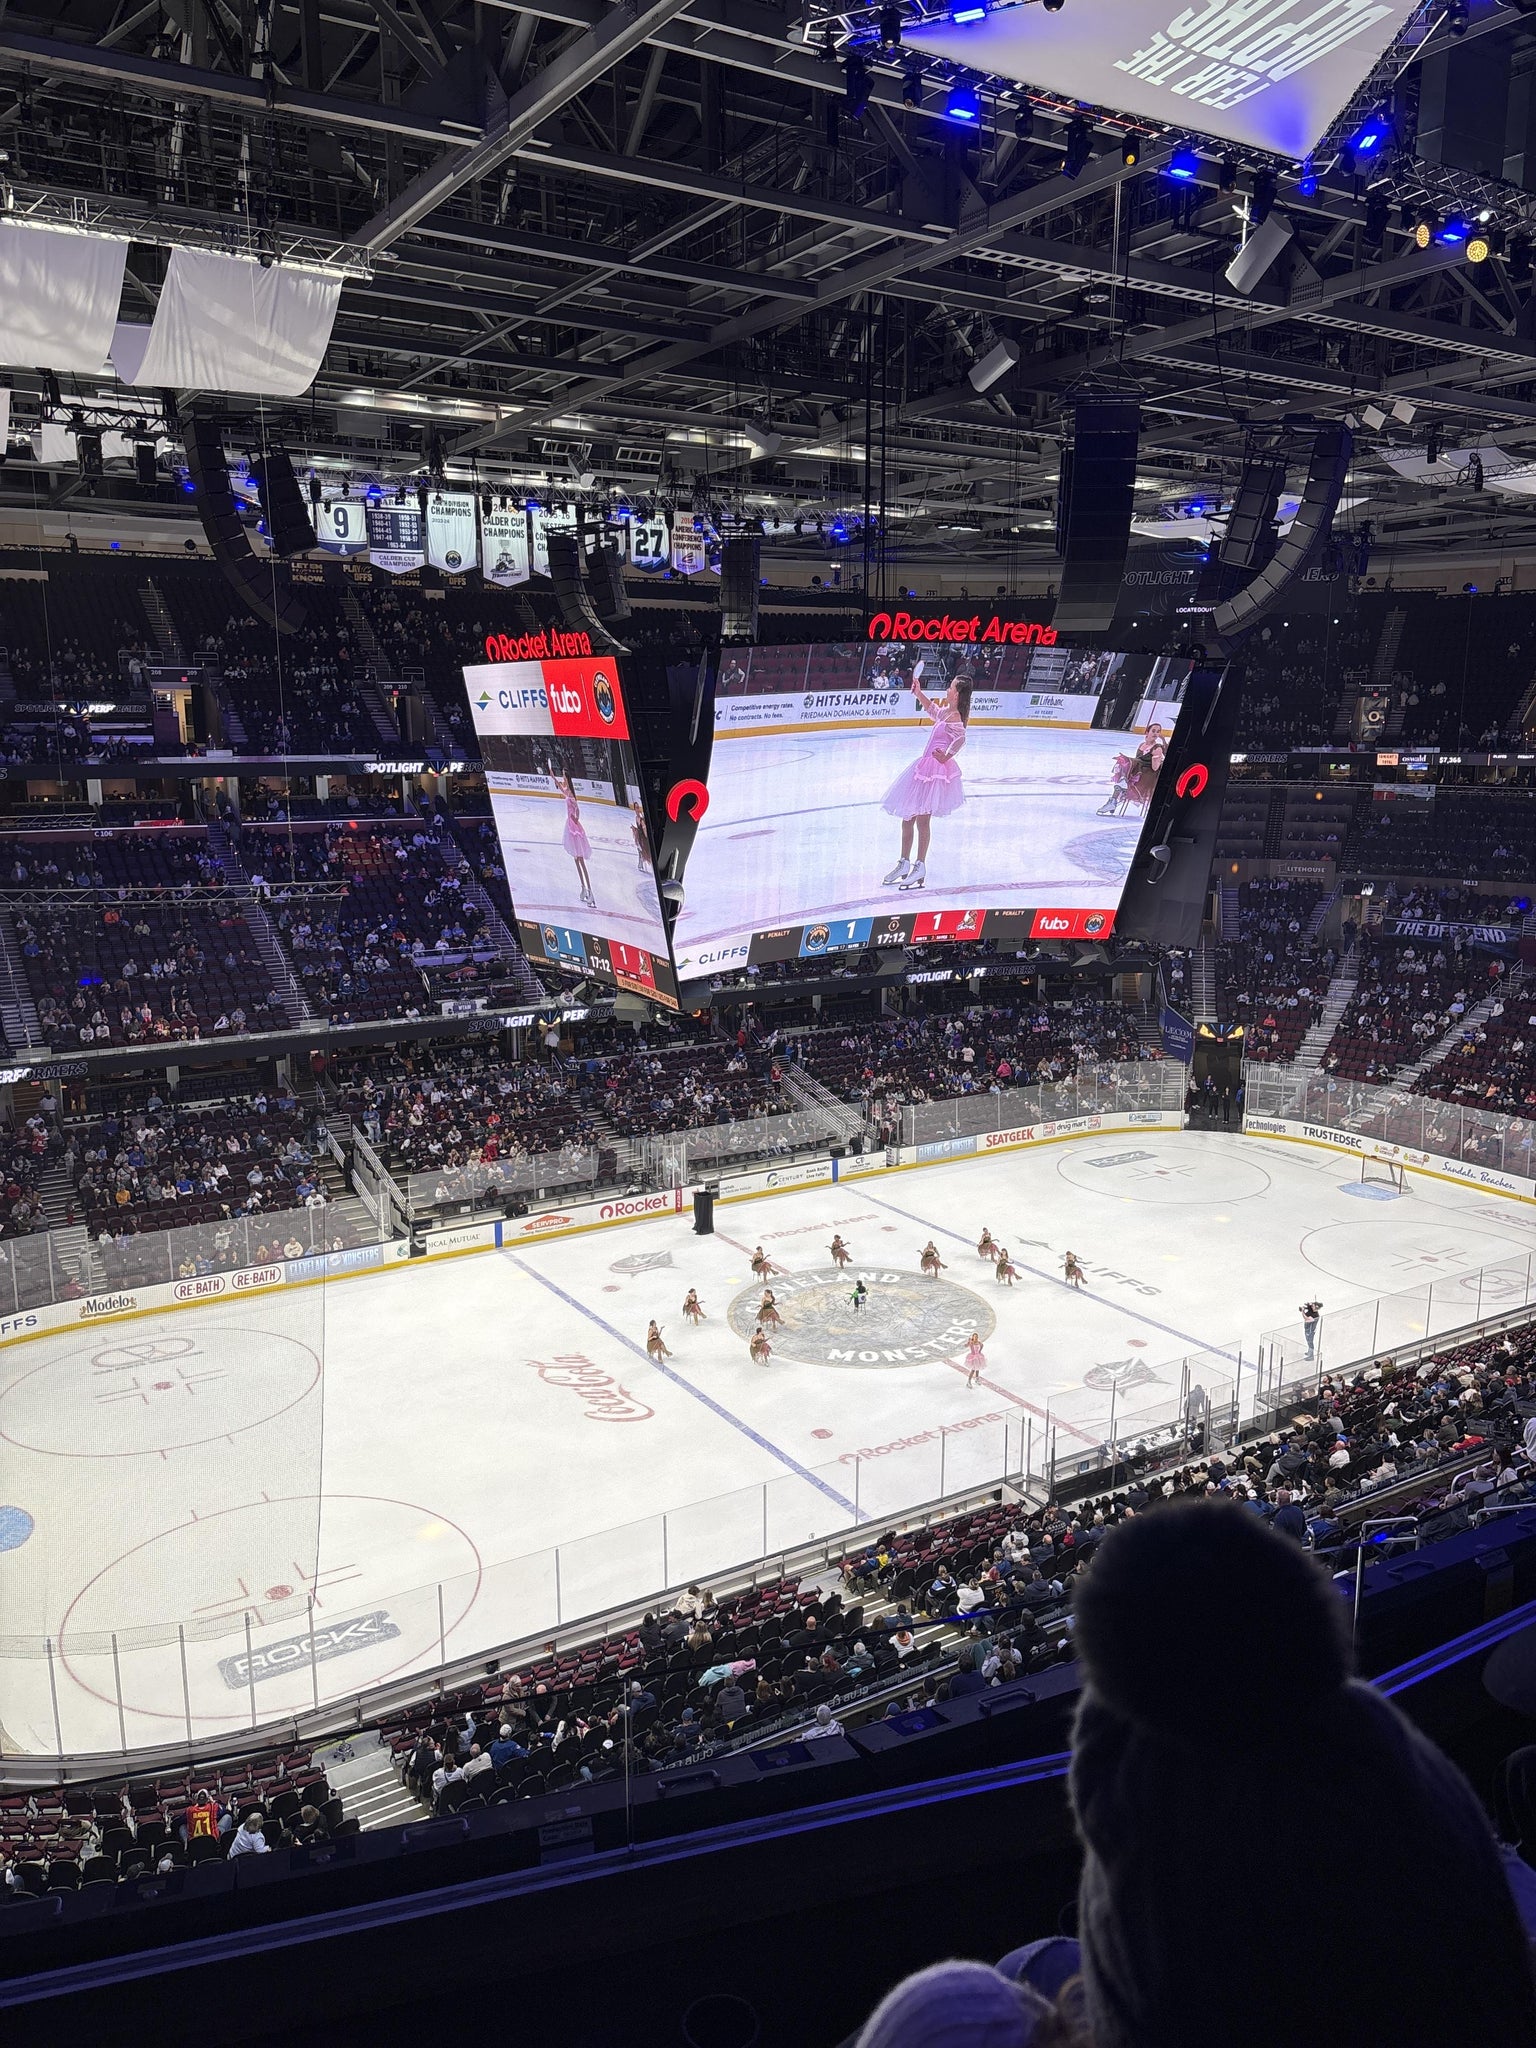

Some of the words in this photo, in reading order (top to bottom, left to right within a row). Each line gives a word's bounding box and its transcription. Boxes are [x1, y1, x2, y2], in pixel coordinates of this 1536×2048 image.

[1112, 31, 1198, 86] THE
[1171, 62, 1271, 110] FEAR
[431, 506, 472, 517] CHAMPIONS
[482, 515, 509, 527] CALDER
[511, 517, 525, 527] CUP
[333, 507, 349, 538] 9
[483, 528, 525, 539] CHAMPIONS
[635, 528, 663, 558] 27
[892, 612, 981, 642] Rocket
[981, 616, 1058, 645] Arena
[498, 629, 551, 661] Rocket
[551, 627, 592, 657] Arena
[498, 688, 549, 709] CLIFFS
[550, 683, 582, 714] fubo
[731, 703, 762, 712] Competitive
[762, 703, 780, 711] energy
[815, 694, 842, 707] HITS
[843, 693, 888, 706] HAPPEN
[975, 697, 999, 705] DRIVING
[14, 704, 67, 713] SPOTLIGHT
[89, 704, 147, 713] PERFORMERS
[800, 710, 833, 720] FRIEDMAN
[833, 709, 865, 719] DOMIANO
[871, 708, 891, 717] SMITH
[363, 762, 425, 773] SPOTLIGHT
[450, 762, 484, 773] PERFO
[1230, 753, 1288, 764] ERFORMERS
[1401, 754, 1427, 762] oswald
[846, 920, 857, 939] 1
[932, 912, 943, 931] 1
[1039, 916, 1069, 931] fubo
[564, 931, 572, 949] 1
[767, 929, 791, 939] PENALTY
[877, 931, 905, 945] 17:12
[1394, 921, 1426, 937] THE
[1473, 927, 1507, 943] END
[590, 956, 612, 972] 17:12
[619, 945, 628, 965] 1
[698, 945, 749, 965] CLIFFS
[906, 969, 953, 984] SPOTLIGHT
[973, 965, 1036, 978] PERFORMERS
[468, 1014, 535, 1033] SPOTLIGHT
[563, 1007, 616, 1022] PERFORM
[1165, 1025, 1193, 1039] LECOM
[1056, 1122, 1071, 1131] drug
[1071, 1120, 1087, 1128] mart
[986, 1127, 1034, 1148] SEATGEEK
[1303, 1126, 1362, 1149] TRUSTEDSEC
[778, 1173, 803, 1183] CENTURY
[615, 1194, 668, 1217] Rocket
[773, 1223, 833, 1238] Rocket
[833, 1213, 880, 1227] Arena
[449, 1233, 480, 1244] MUTUAL
[288, 1256, 328, 1275] CLEVELAND
[343, 1248, 380, 1266] MONSTERS
[86, 1296, 130, 1314] Modelo
[0, 1314, 38, 1335] FFS
[826, 1316, 978, 1362] MONSTERS
[523, 1351, 656, 1423] Coca-Cola
[856, 1430, 940, 1460] Rocket
[938, 1412, 1004, 1436] Arena
